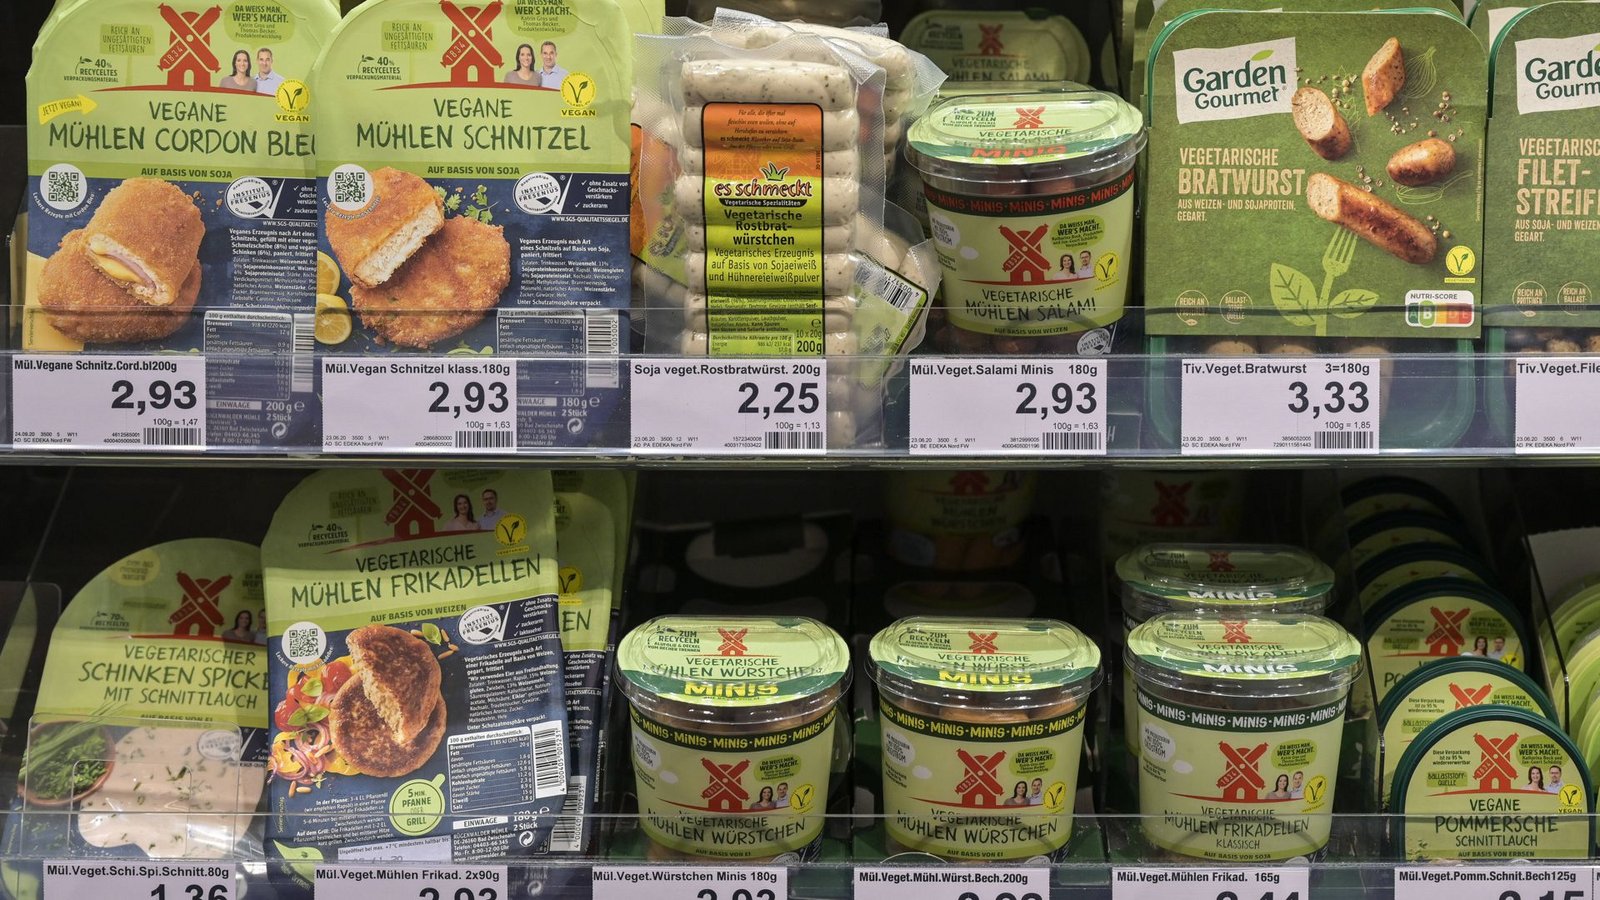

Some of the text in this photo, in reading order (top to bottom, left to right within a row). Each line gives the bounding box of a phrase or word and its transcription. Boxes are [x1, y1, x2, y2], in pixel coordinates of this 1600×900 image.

[245, 5, 265, 13] WEISS
[233, 13, 288, 23] WER'S MACHT.
[95, 59, 112, 68] 40%
[80, 68, 118, 76] RECYCELTES
[1183, 61, 1286, 93] Garden
[1195, 87, 1279, 109] Gourmet
[42, 104, 57, 116] JETZT
[150, 101, 227, 123] VEGANE
[434, 98, 512, 119] VEGANE
[276, 114, 309, 122] VEGAN
[49, 123, 144, 150] MÜHLEN
[156, 128, 256, 153] CORDON
[357, 123, 591, 150] MÜHLEN SCHNITZEL
[1180, 148, 1278, 166] VEGETARISCHE
[141, 168, 232, 178] AUF BASIS VON SOJA
[1518, 159, 1590, 185] FILET-
[1178, 168, 1305, 195] BRATWURST
[233, 186, 265, 198] INSTITUT
[714, 179, 812, 197] es schmeckt
[230, 192, 270, 205] FRESENIUS
[1178, 199, 1296, 210] AUS WEIZEN- UND SOJAPROTEIN.
[725, 210, 802, 221] Vegetarische
[1177, 211, 1207, 221] GEGART.
[736, 222, 792, 231] Rostbrat-
[1515, 220, 1530, 229] AUS
[1532, 220, 1553, 230] SOJA-
[1557, 221, 1571, 230] UND
[733, 234, 795, 245] würstchen
[1515, 232, 1544, 242] GEGART.
[714, 248, 814, 258] Vegetarisches Erzeugnis
[712, 260, 725, 269] auf
[729, 261, 750, 269] Basis
[771, 261, 816, 271] Sojaeiweiß
[709, 273, 724, 281] und
[982, 288, 1072, 302] VEGETARISCHE
[966, 298, 1096, 320] MÜHLEN SALAMI
[797, 341, 821, 354] 200g
[14, 360, 73, 372] Mül.Vegane
[325, 363, 510, 376] Mül.Vegan Schnitzel klass.180g
[634, 364, 821, 376] Soja veget.Rostbratwürst. 200g
[911, 364, 1098, 377] Mül.Veget.Salami Minis 180g
[1184, 363, 1370, 376] Tiv.Veget.Bratwurst 3=180g
[111, 380, 197, 415] 2,93
[428, 381, 509, 419] 2,93
[738, 382, 820, 420] 2,25
[1015, 382, 1097, 420] 2,93
[1288, 381, 1369, 420] 3,33
[775, 422, 794, 430] 100g
[804, 422, 820, 430] 1,13
[1325, 421, 1343, 430] 100g
[1354, 421, 1370, 430] 1,85
[355, 545, 475, 573] VEGETARISCHE
[291, 554, 541, 608] MÜHLEN FRIKADELLEN
[124, 644, 255, 666] VEGETARISCHER
[687, 657, 779, 667] VEGETARISCHE
[79, 662, 194, 686] SCHINKEN
[104, 687, 257, 709] MIT SCHNITTLAUCH
[1519, 748, 1560, 756] WER'S MACHT.
[407, 788, 427, 797] 5 MIN.
[401, 797, 432, 807] PFANNE
[1470, 798, 1520, 812] VEGANE
[406, 816, 427, 826] GRILL
[463, 817, 498, 827] EINWAAGE
[520, 821, 538, 830] Stück
[648, 810, 805, 844] MÜHLEN WÜRSTCHEN
[897, 810, 1057, 844] MÜHLEN WÜRSTCHEN
[1165, 809, 1309, 838] MÜHLEN FRIKADELLEN
[1436, 816, 1558, 834] POMMERSCHE
[1216, 838, 1260, 849] KLASSISCH
[1456, 835, 1538, 846] SCHNITTLAUCH
[316, 870, 500, 882] Mül.Veget.Mühlen Frikad. 2x90g
[593, 871, 777, 884] Mül.Veget.Würstchen Minis 180g
[1117, 872, 1280, 884] Mül.Veget.Mühlen Frikad. 165g
